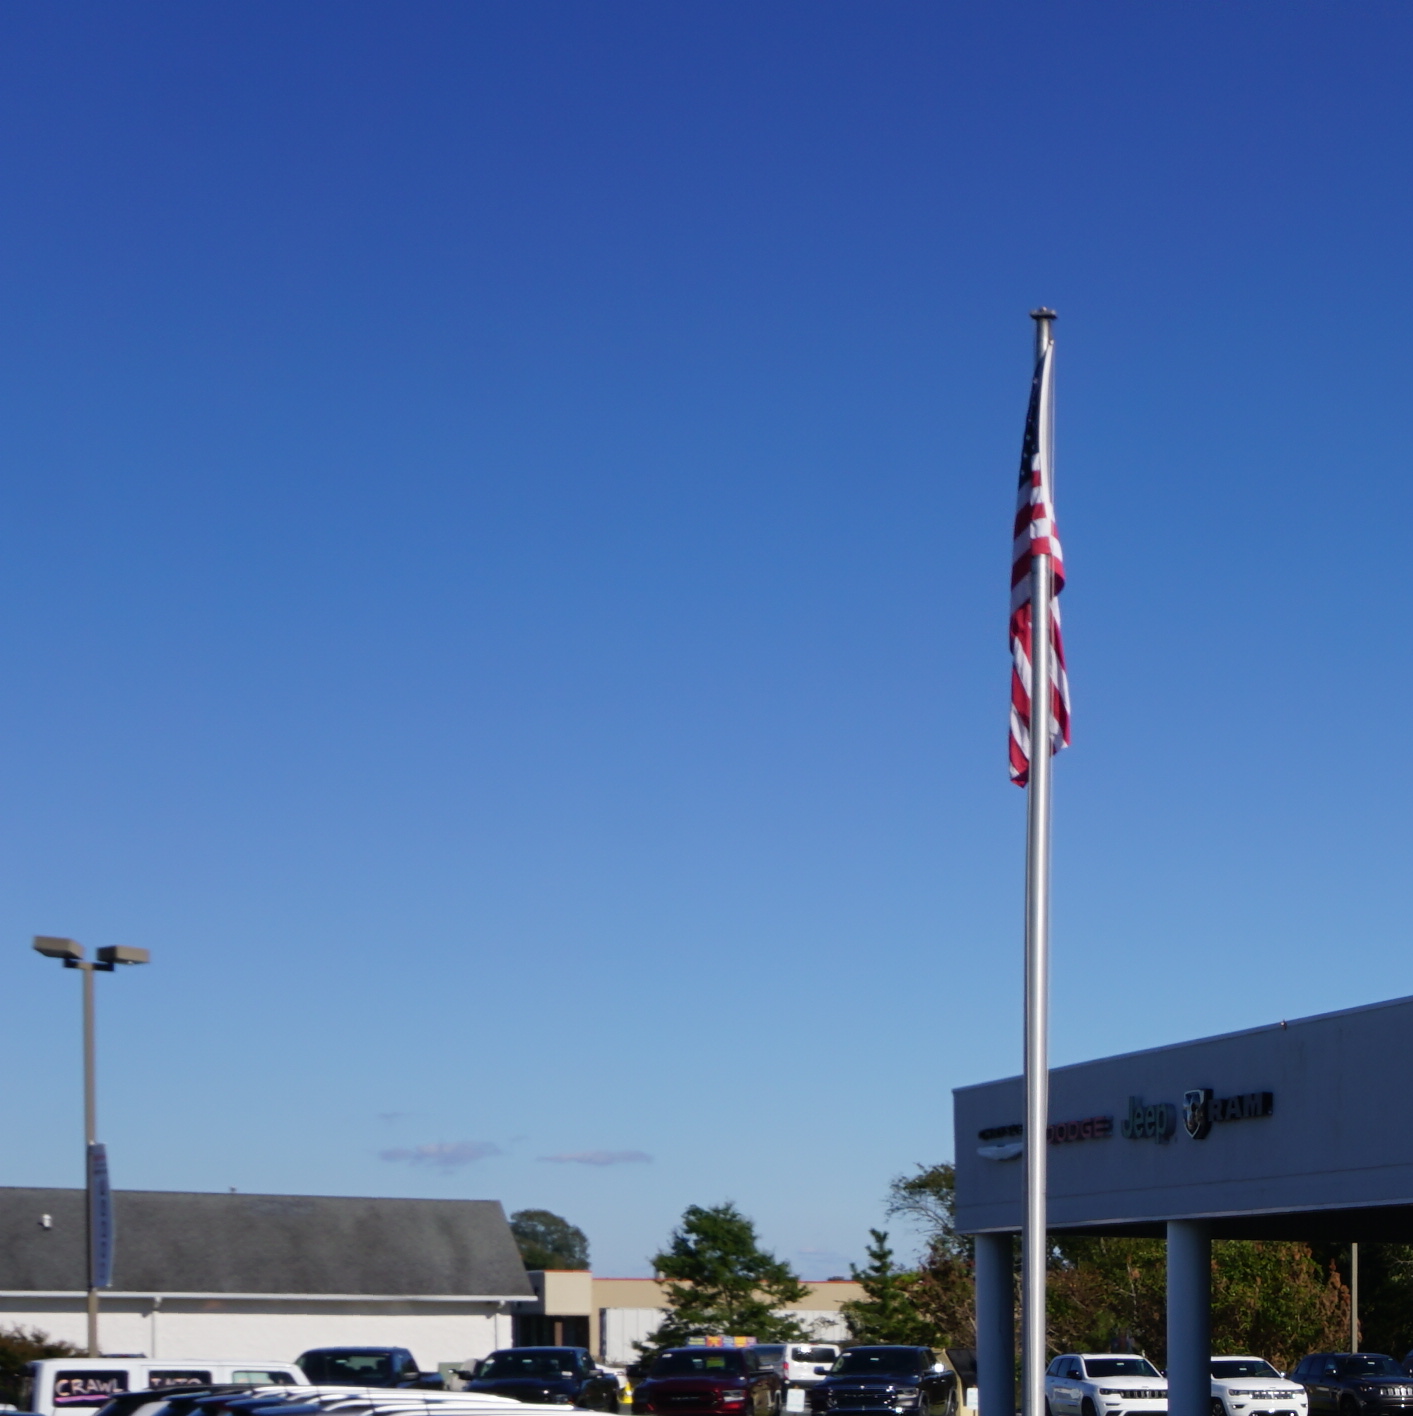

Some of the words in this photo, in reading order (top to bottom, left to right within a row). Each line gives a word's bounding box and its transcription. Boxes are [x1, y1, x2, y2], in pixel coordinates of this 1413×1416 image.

[1121, 1096, 1175, 1144] Jeep
[1208, 1092, 1271, 1122] RAM
[1046, 1116, 1112, 1145] DODGE
[55, 1378, 124, 1397] CRAWL
